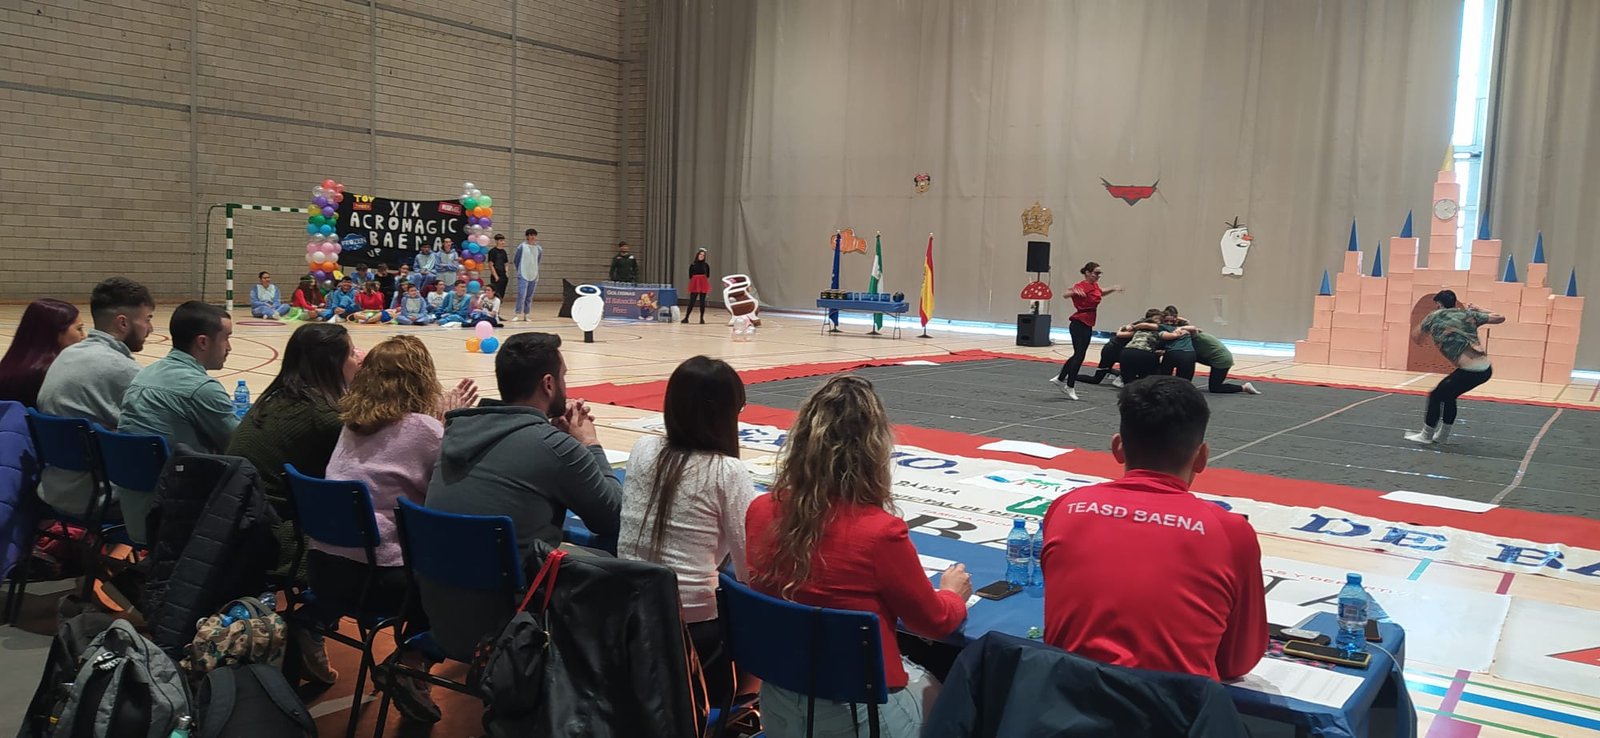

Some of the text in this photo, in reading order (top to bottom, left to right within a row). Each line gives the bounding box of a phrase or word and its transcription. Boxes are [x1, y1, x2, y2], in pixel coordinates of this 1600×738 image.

[353, 194, 375, 203] TOY
[388, 201, 421, 217] XIX
[350, 211, 459, 235] ACROMAGIC
[369, 231, 443, 252] BAENA
[367, 248, 382, 258] UP
[894, 480, 960, 495] BAENA
[960, 504, 983, 513] DE
[1067, 502, 1206, 536] TEASD BAENA
[1290, 513, 1448, 552] DE
